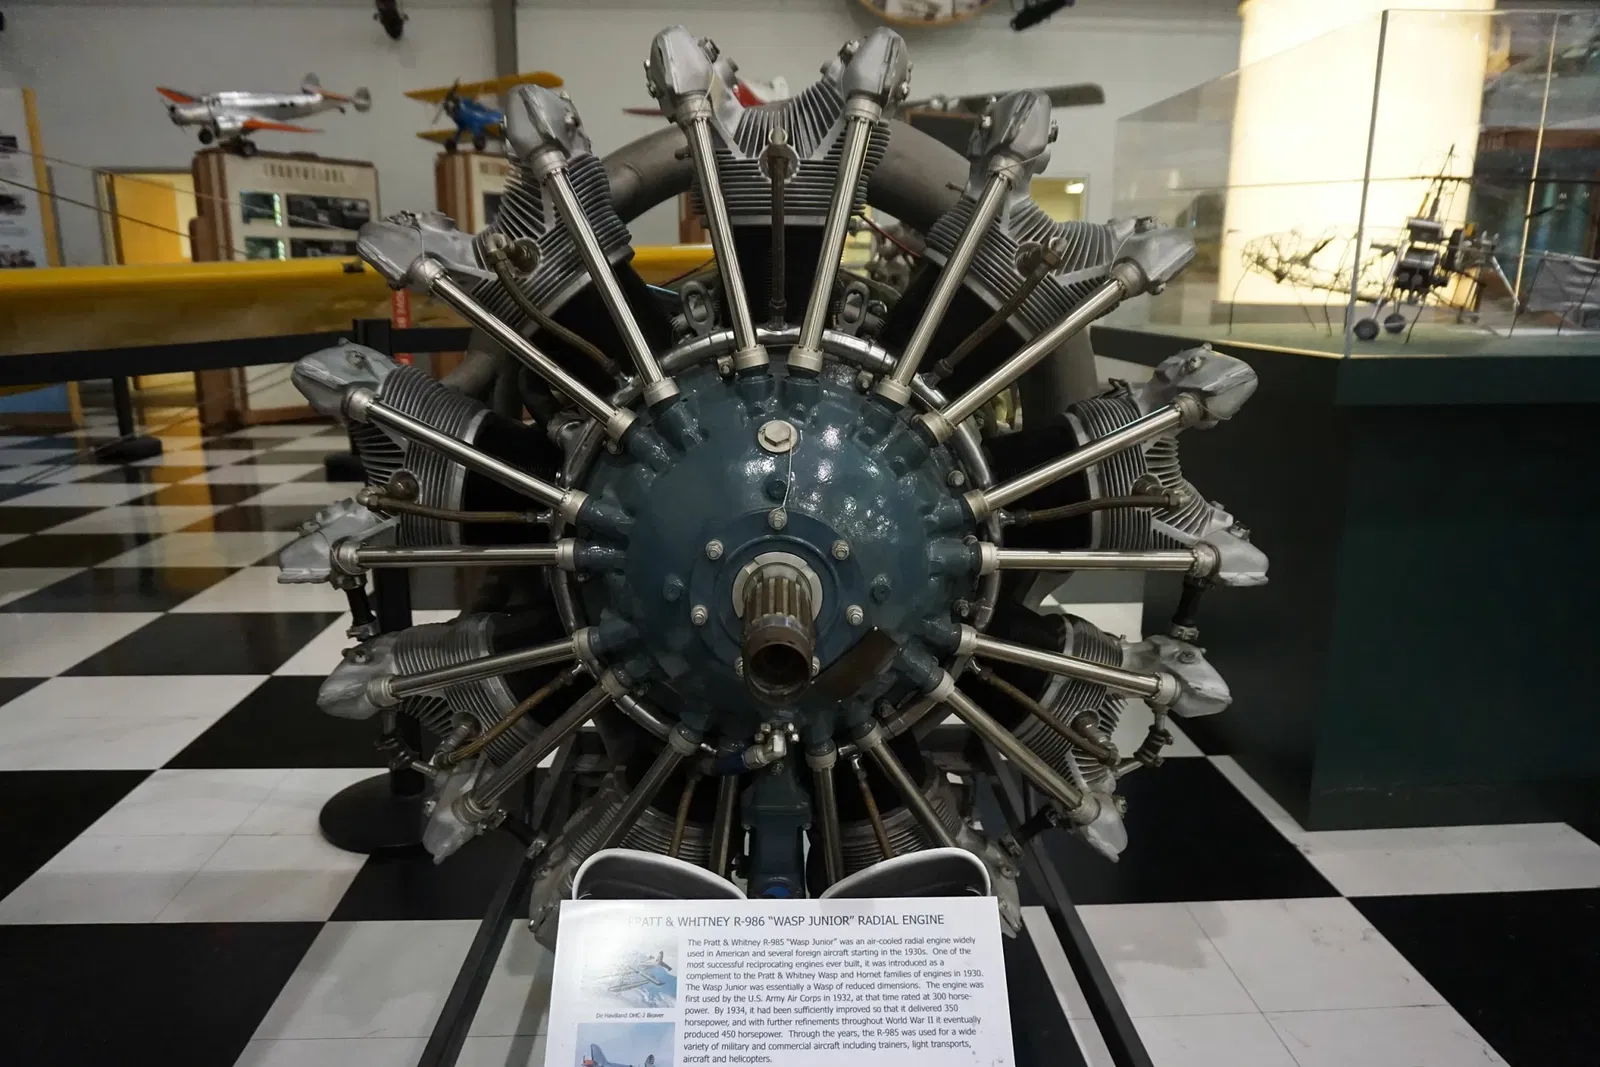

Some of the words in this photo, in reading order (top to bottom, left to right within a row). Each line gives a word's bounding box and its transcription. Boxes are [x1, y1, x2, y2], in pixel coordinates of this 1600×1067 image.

[666, 917, 674, 926] &
[678, 917, 730, 926] WHITNEY
[734, 916, 765, 926] R-986
[768, 916, 805, 926] "WASP
[808, 916, 854, 926] JUNIOR"
[858, 915, 900, 925] RADIAL
[902, 914, 944, 925] ENGINE
[796, 950, 821, 958] foreign
[746, 961, 793, 969] reciprocating
[795, 961, 824, 969] engines
[786, 972, 815, 980] Whitney
[766, 984, 804, 992] essentially
[814, 983, 834, 991] Wasp
[722, 995, 731, 1004] by
[766, 995, 785, 1003] Army
[800, 994, 821, 1003] Corps
[834, 994, 853, 1002] 1932,
[714, 1006, 724, 1016] By
[727, 1006, 747, 1015] 1934,
[794, 1006, 834, 1014] sufficiently
[836, 1005, 870, 1014] improved
[684, 1019, 730, 1027] horsepower,
[842, 1017, 884, 1026] throughout
[943, 1016, 981, 1026] eventually
[684, 1030, 719, 1039] produced
[738, 1031, 783, 1039] horsepower.
[788, 1030, 820, 1039] Through
[684, 1043, 709, 1052] variety
[711, 1042, 719, 1050] of
[722, 1042, 749, 1052] military
[768, 1042, 811, 1050] commercial
[814, 1042, 840, 1050] aircraft
[843, 1042, 876, 1050] including
[912, 1040, 928, 1050] light
[931, 1040, 971, 1048] transports,
[683, 1055, 710, 1063] aircraft
[729, 1055, 772, 1064] helicopters.
